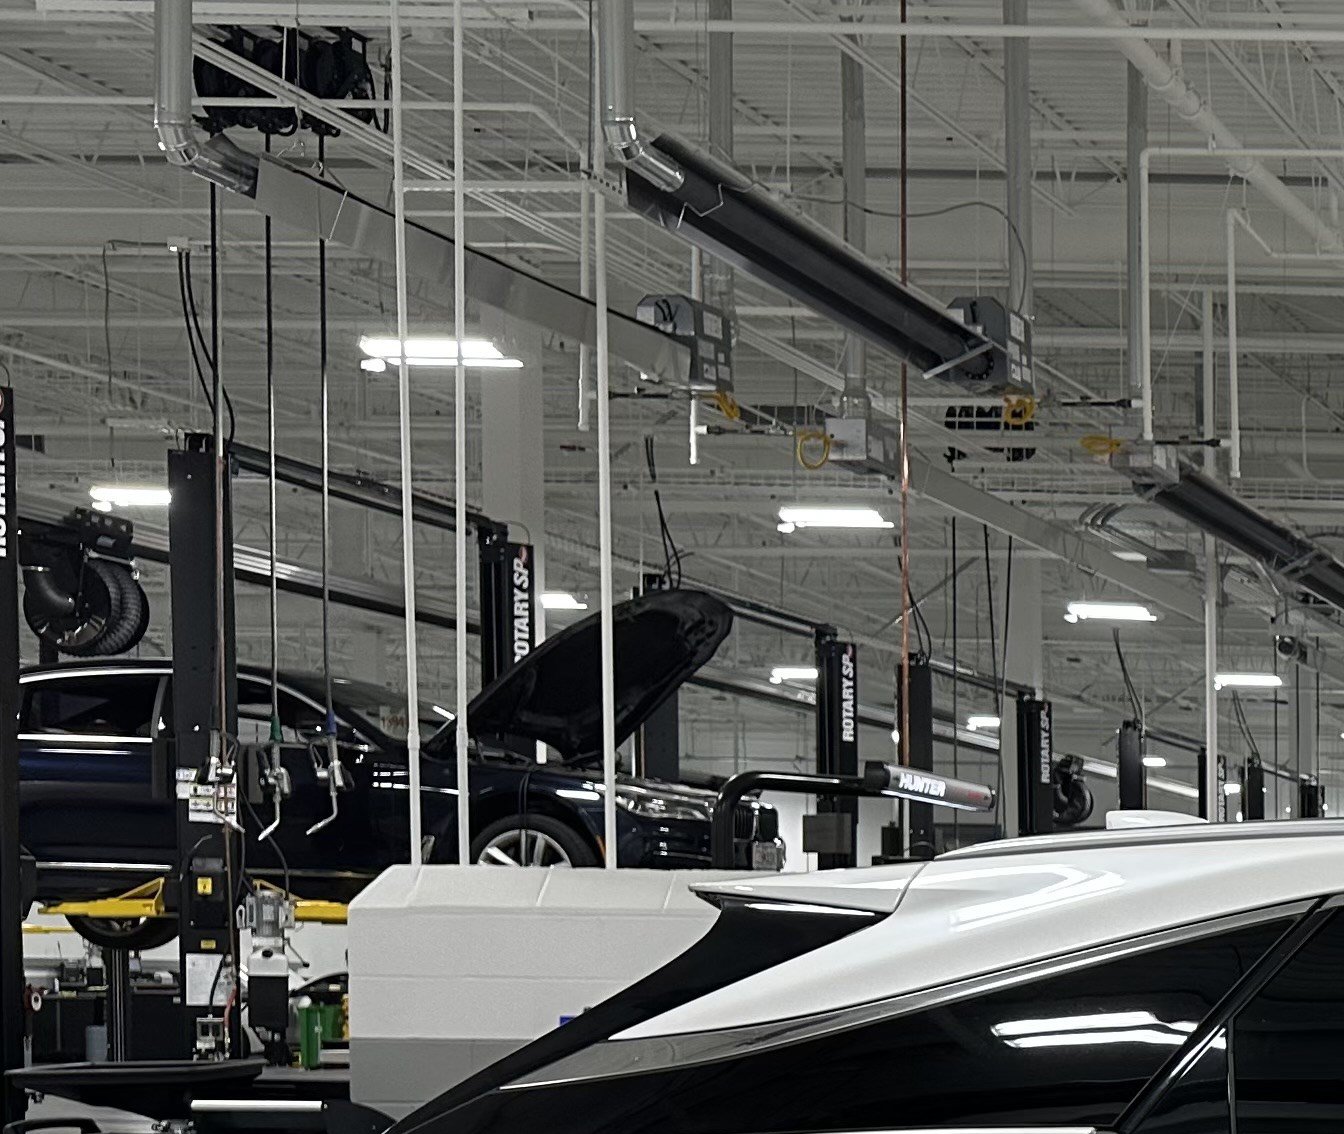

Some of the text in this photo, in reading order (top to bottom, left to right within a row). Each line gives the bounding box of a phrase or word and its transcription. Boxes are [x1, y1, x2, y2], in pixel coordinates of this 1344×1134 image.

[513, 557, 529, 589] SP
[842, 653, 855, 742] ROTARY SP
[1041, 730, 1051, 784] ROTARY
[899, 772, 946, 798] HUNTER
